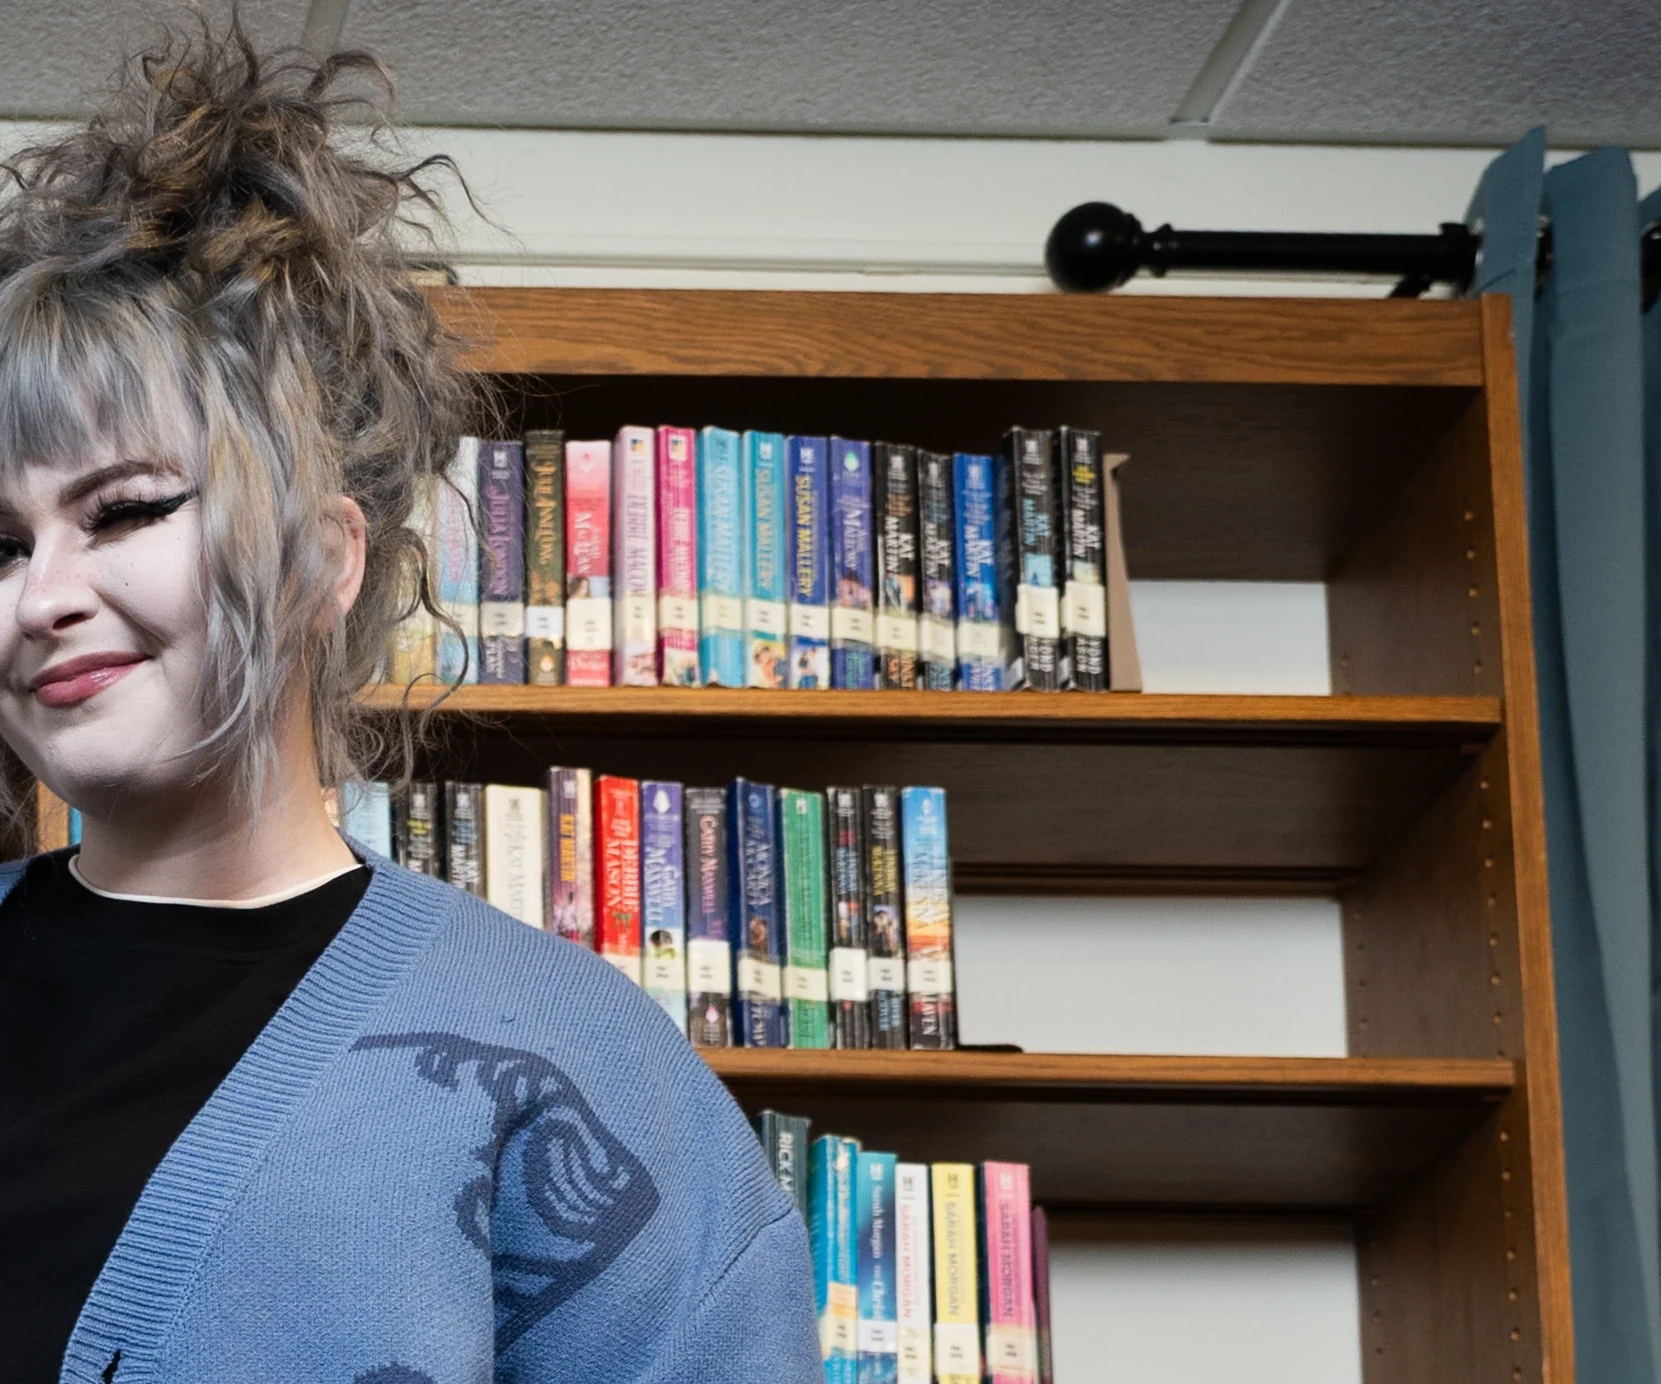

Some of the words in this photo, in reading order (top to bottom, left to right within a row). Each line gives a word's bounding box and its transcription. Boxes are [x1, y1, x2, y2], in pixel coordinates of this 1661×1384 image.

[485, 486, 509, 533] JULIA
[795, 475, 812, 526] SUSAN
[1072, 509, 1089, 557] MARTIN
[1087, 525, 1101, 549] KAT
[491, 535, 511, 595] LONDON
[796, 528, 813, 597] MALLERY
[606, 838, 621, 906] MASON
[622, 840, 638, 912] DEBBIE
[779, 1132, 793, 1173] RICK
[872, 1185, 884, 1216] Sarah
[871, 1220, 884, 1258] Morgan
[999, 1204, 1009, 1249] SARAH
[1001, 1253, 1013, 1317] MORGAN
